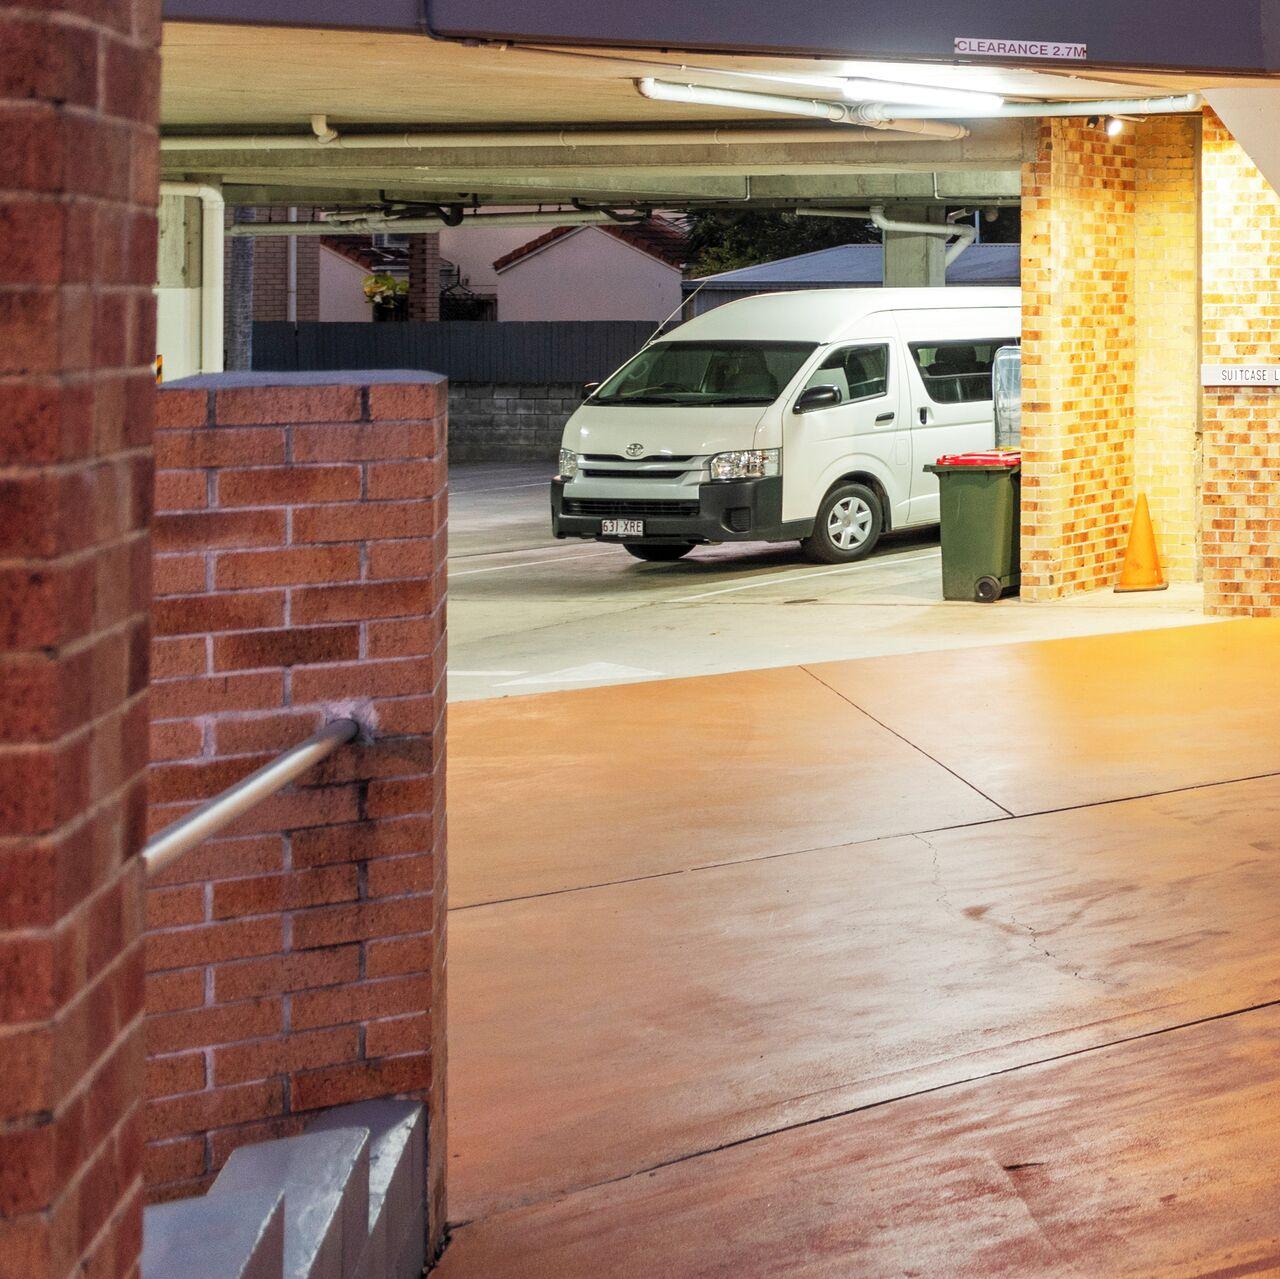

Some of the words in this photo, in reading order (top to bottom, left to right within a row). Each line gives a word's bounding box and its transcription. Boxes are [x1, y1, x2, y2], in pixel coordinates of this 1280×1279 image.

[957, 40, 1048, 56] CLEARANCE
[1052, 46, 1086, 58] 2.7M
[1221, 369, 1267, 381] SUITCASE
[603, 521, 619, 532] 631
[623, 521, 642, 532] XRE
